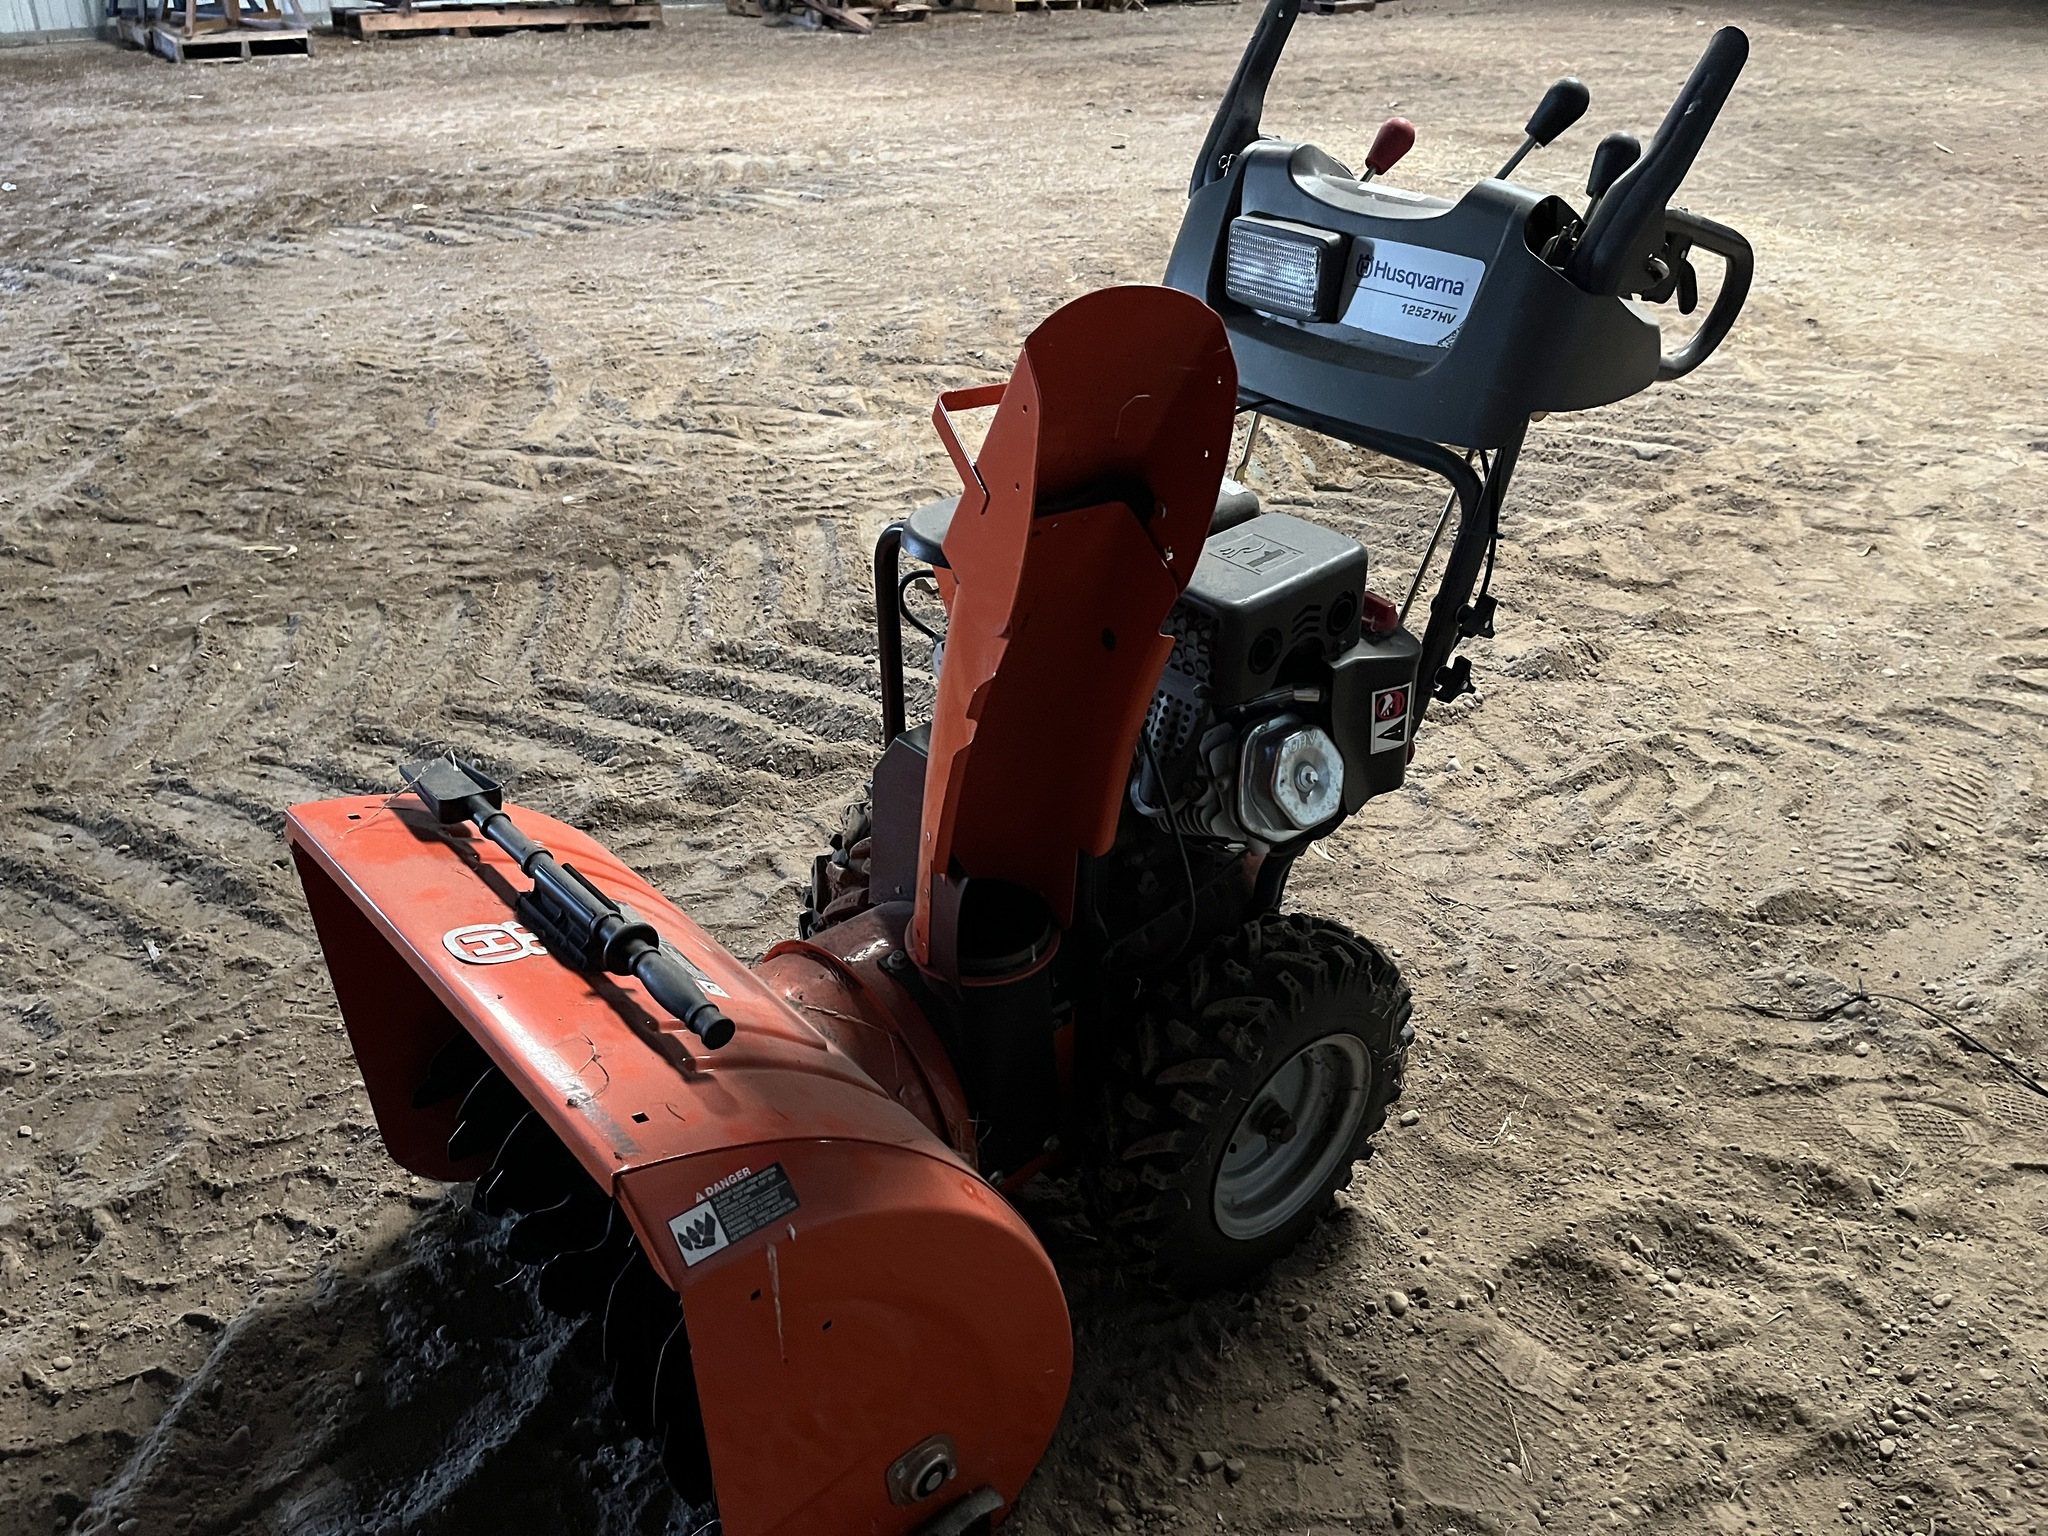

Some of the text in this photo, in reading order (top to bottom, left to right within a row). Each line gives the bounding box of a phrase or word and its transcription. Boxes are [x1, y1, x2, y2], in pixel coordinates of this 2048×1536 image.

[1374, 260, 1465, 296] Husqvarna
[1401, 303, 1457, 325] 12527HV
[705, 1166, 752, 1197] DANGER
